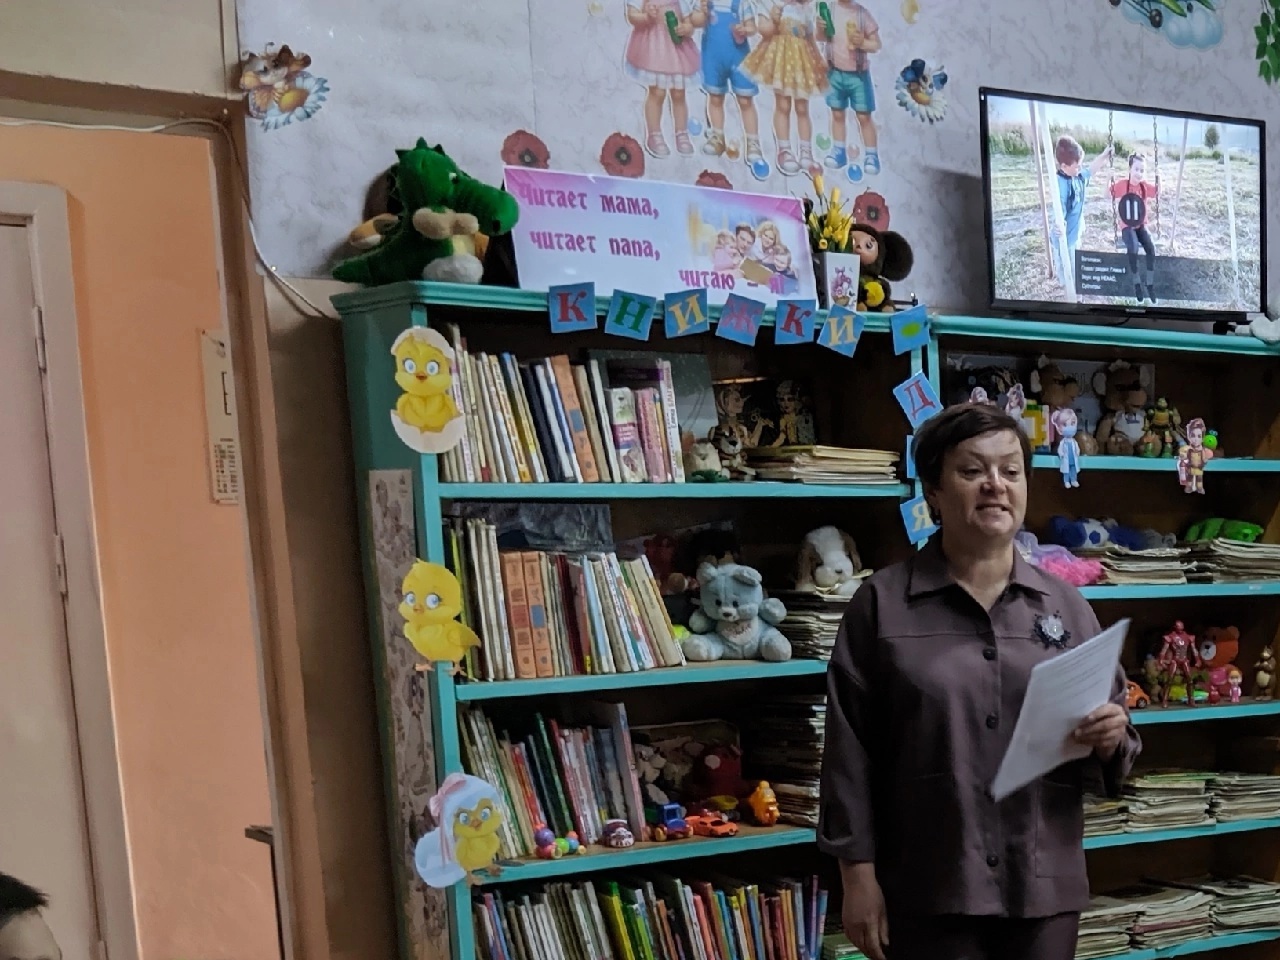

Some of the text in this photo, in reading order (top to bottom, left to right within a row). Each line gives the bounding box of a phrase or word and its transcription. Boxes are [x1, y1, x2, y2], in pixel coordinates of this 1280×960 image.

[518, 183, 660, 219] Читает мама,
[530, 230, 661, 261] читает папа,
[678, 270, 736, 290] читаю
